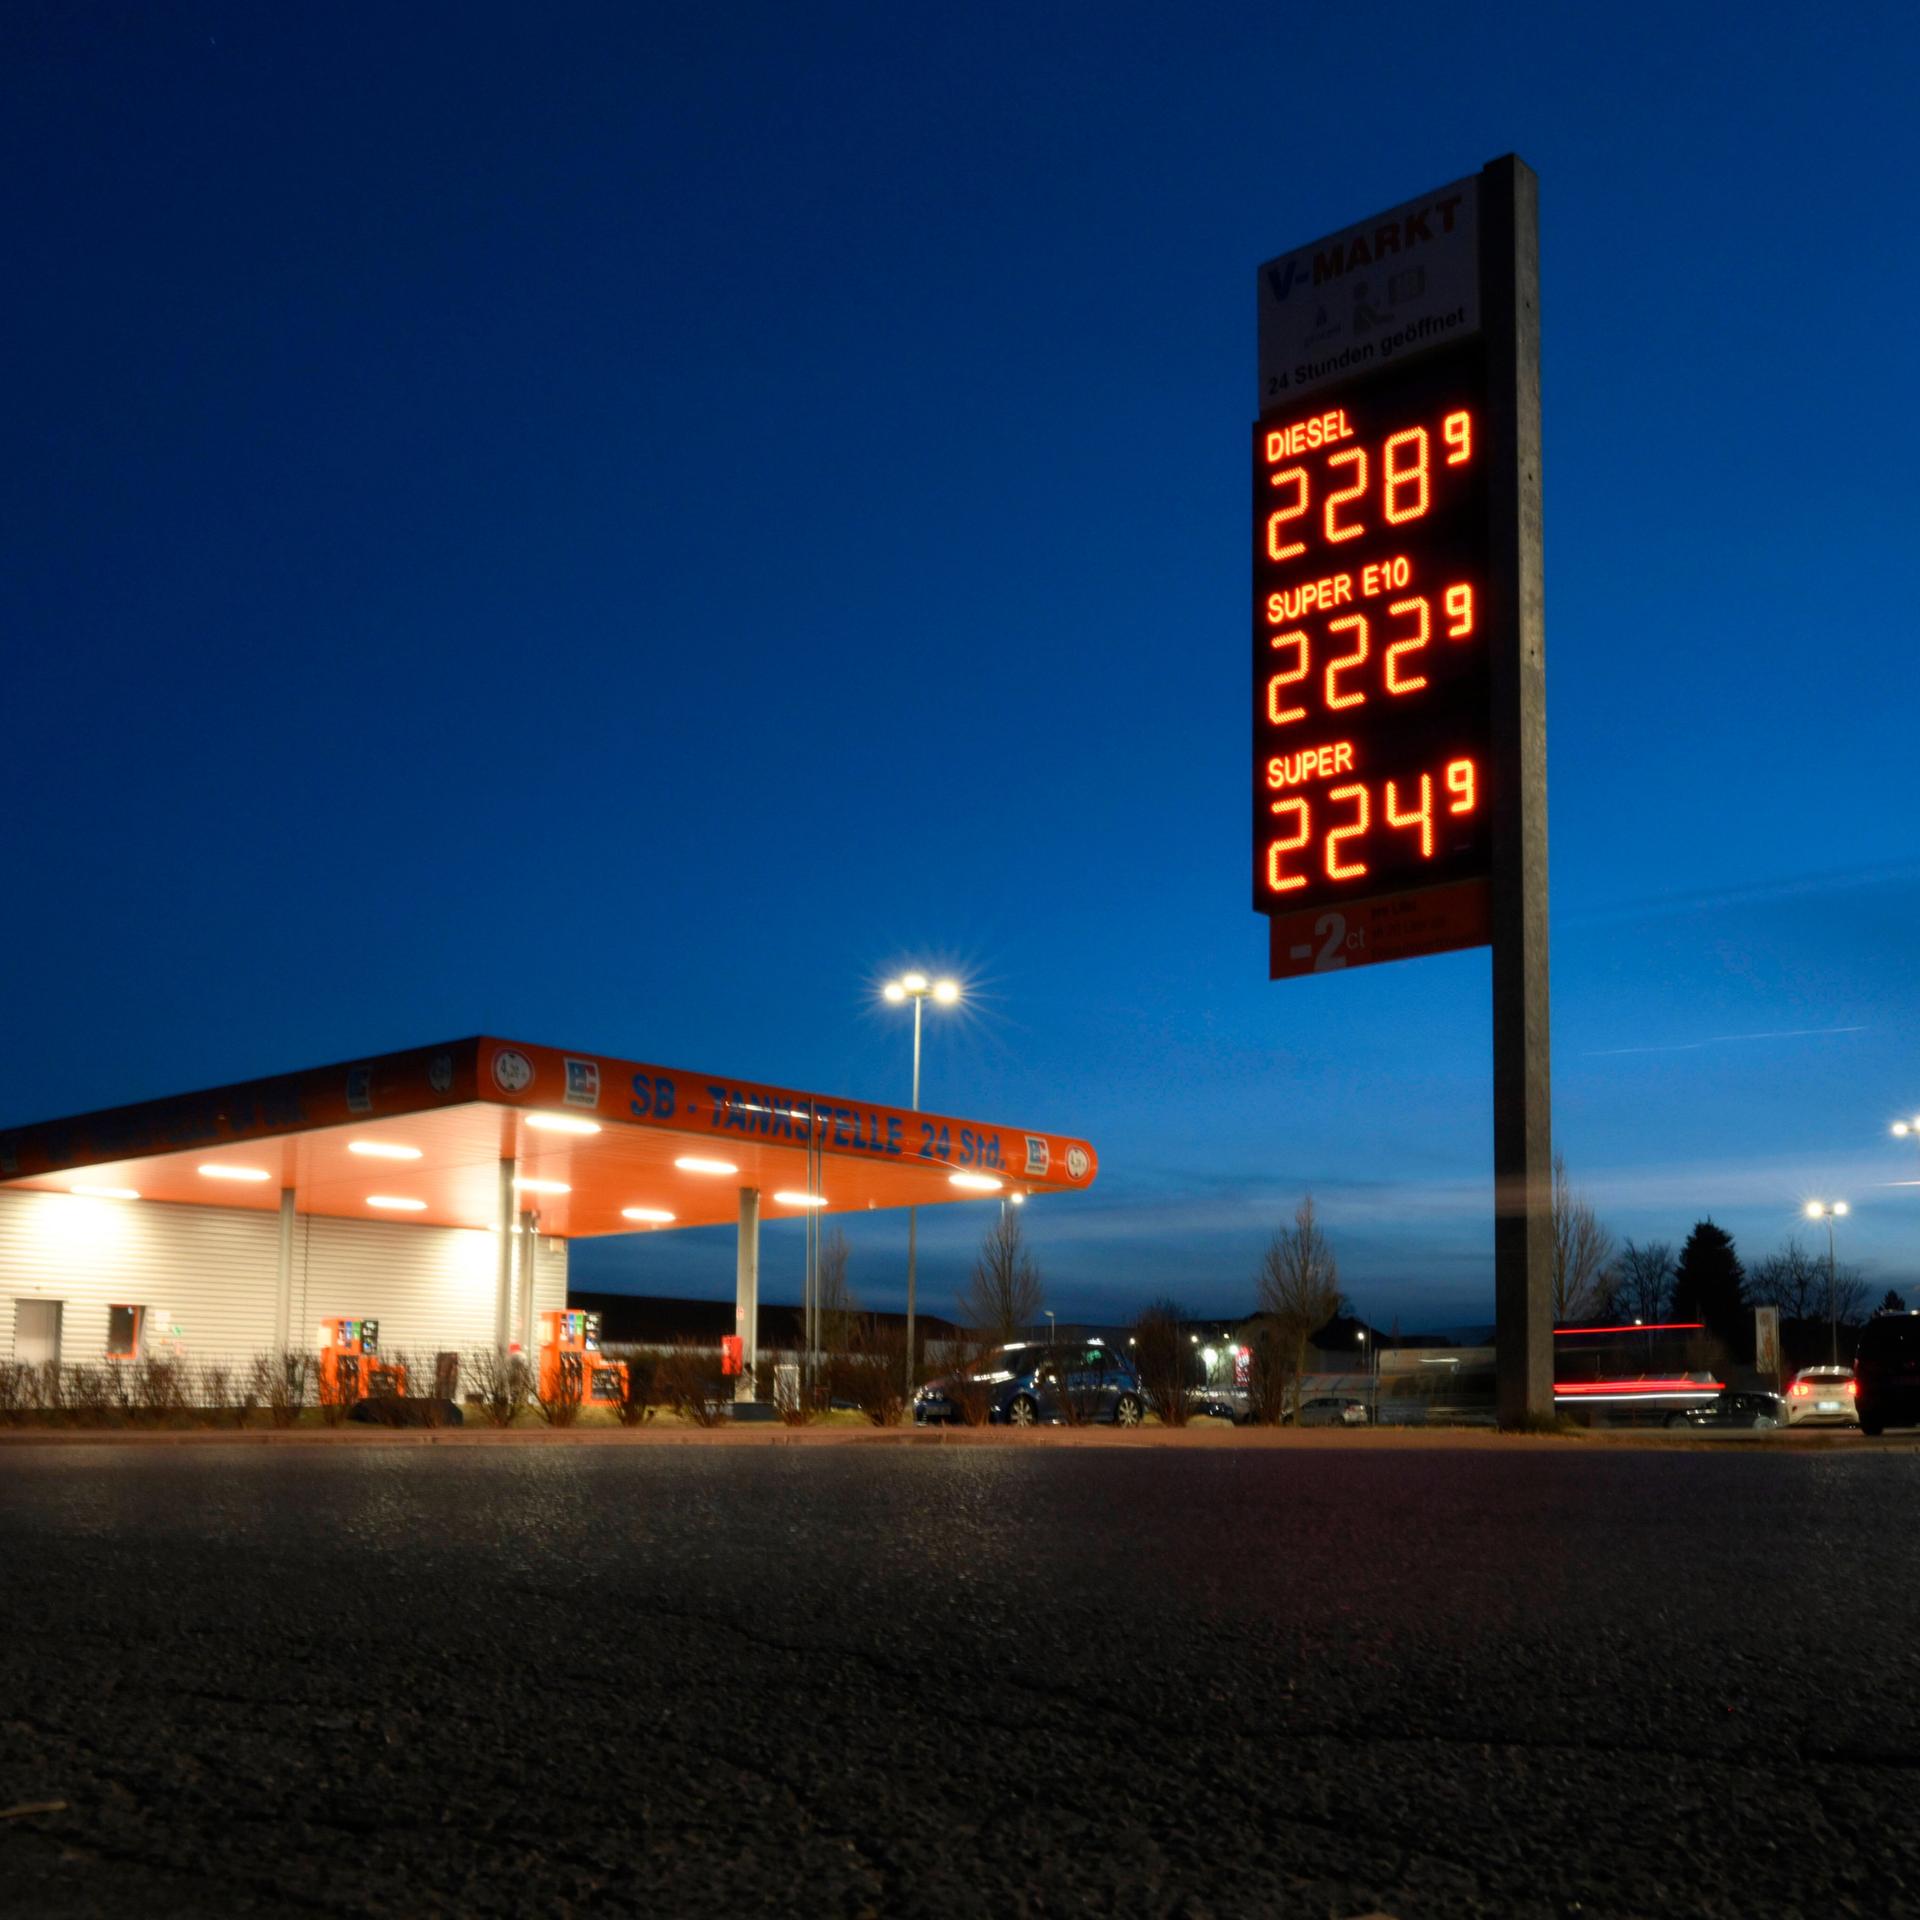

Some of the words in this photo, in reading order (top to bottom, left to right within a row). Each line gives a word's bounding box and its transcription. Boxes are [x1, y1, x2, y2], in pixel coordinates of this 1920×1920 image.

[1268, 372, 1288, 396] 24
[1295, 344, 1375, 386] Stunden
[1381, 306, 1466, 357] geöffnet
[1266, 409, 1355, 463] DIESEL
[1267, 573, 1353, 625] SUPER
[1362, 555, 1411, 597] E10
[1267, 741, 1354, 788] SUPER
[631, 1074, 676, 1119] SB
[706, 1085, 904, 1154] TANKSTELLE
[920, 1122, 950, 1159] 24
[959, 1127, 1008, 1169] Std.
